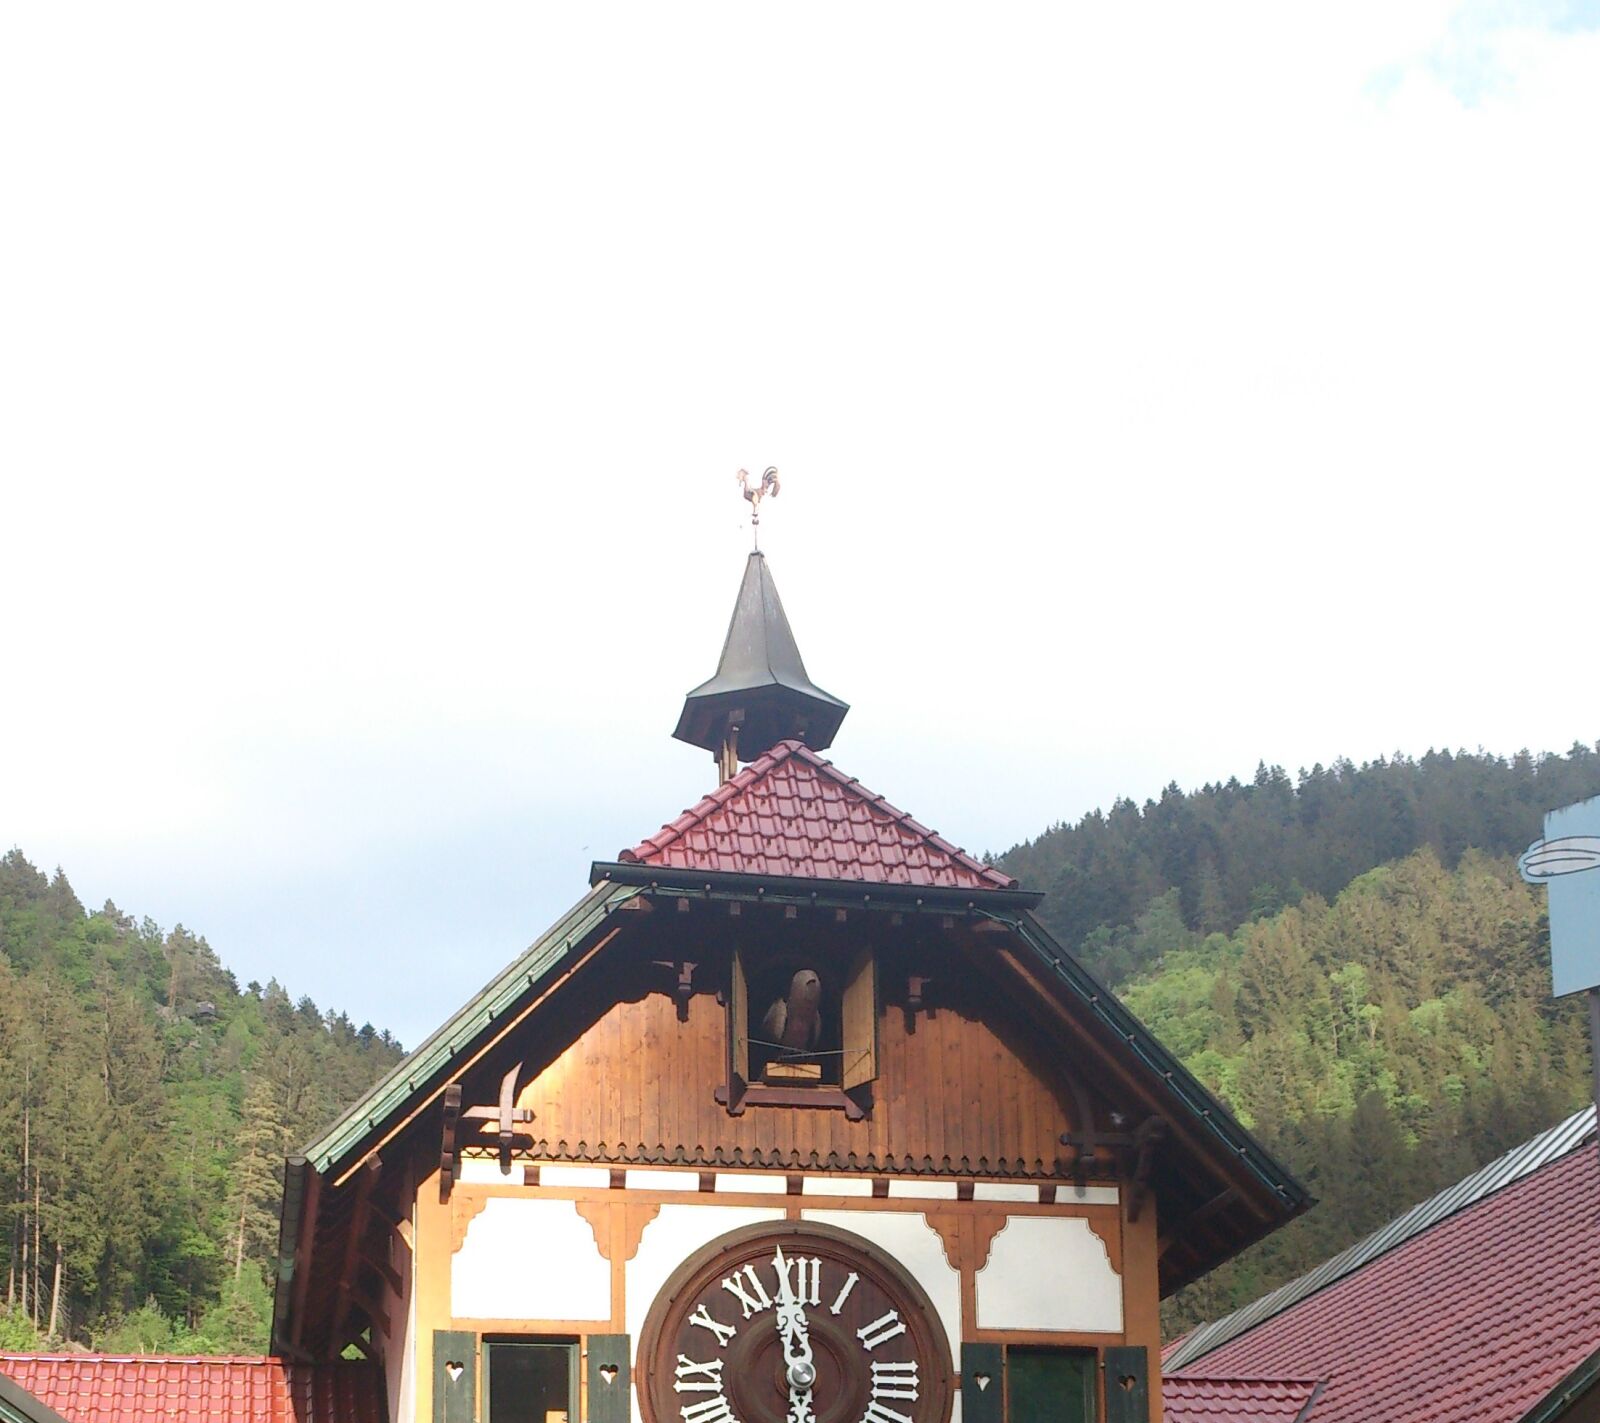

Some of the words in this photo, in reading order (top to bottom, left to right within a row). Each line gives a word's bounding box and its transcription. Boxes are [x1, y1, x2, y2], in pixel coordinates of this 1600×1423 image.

[722, 1264, 773, 1320] XI
[771, 1256, 823, 1307] XII
[830, 1272, 860, 1315] I
[688, 1303, 737, 1347] X
[856, 1309, 906, 1351] II
[673, 1354, 724, 1393] IX
[870, 1360, 920, 1401] III
